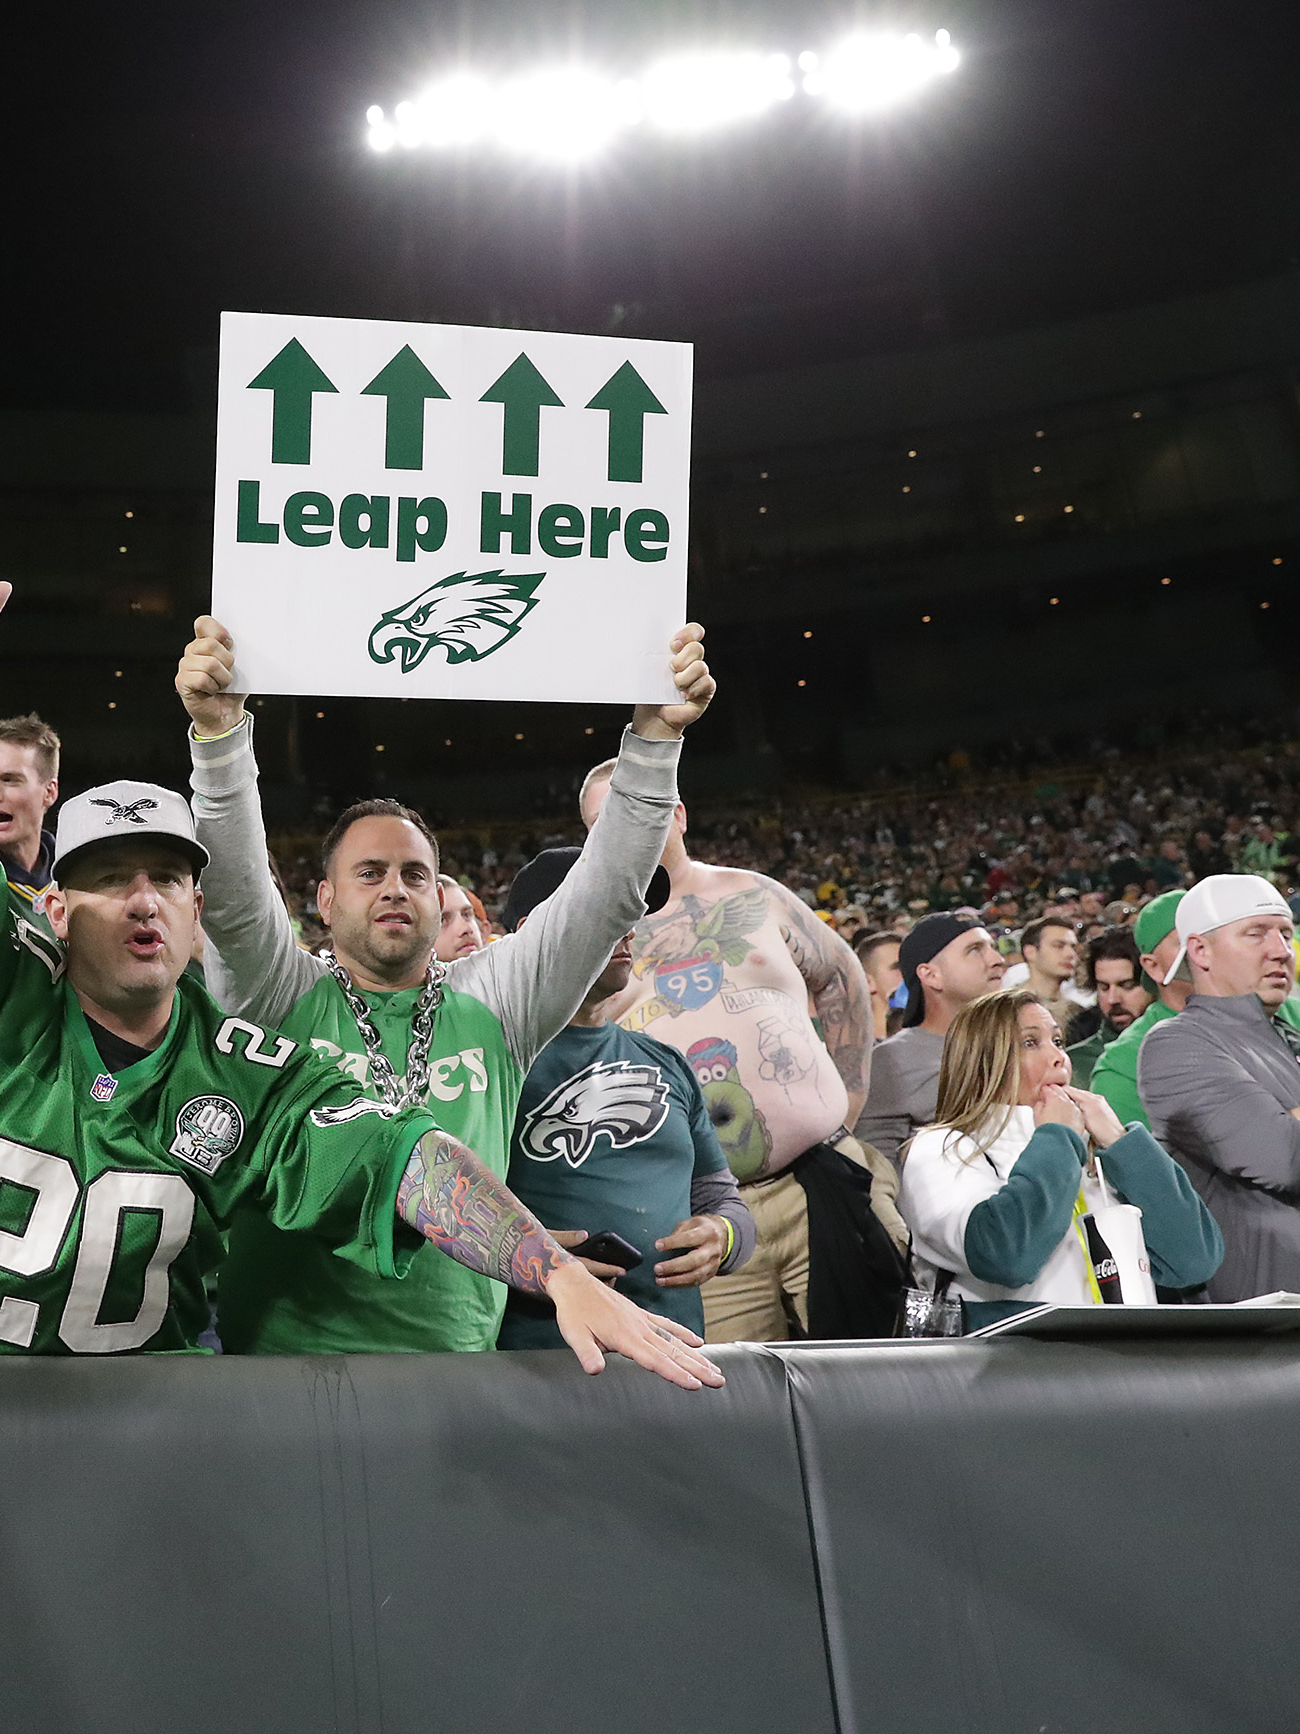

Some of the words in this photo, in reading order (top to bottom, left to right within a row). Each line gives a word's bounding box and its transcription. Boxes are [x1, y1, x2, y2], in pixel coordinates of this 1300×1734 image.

[236, 479, 448, 563] Leap
[480, 491, 670, 563] Here
[666, 967, 715, 999] 95
[214, 1017, 297, 1068] 2
[185, 1099, 226, 1119] JEROME
